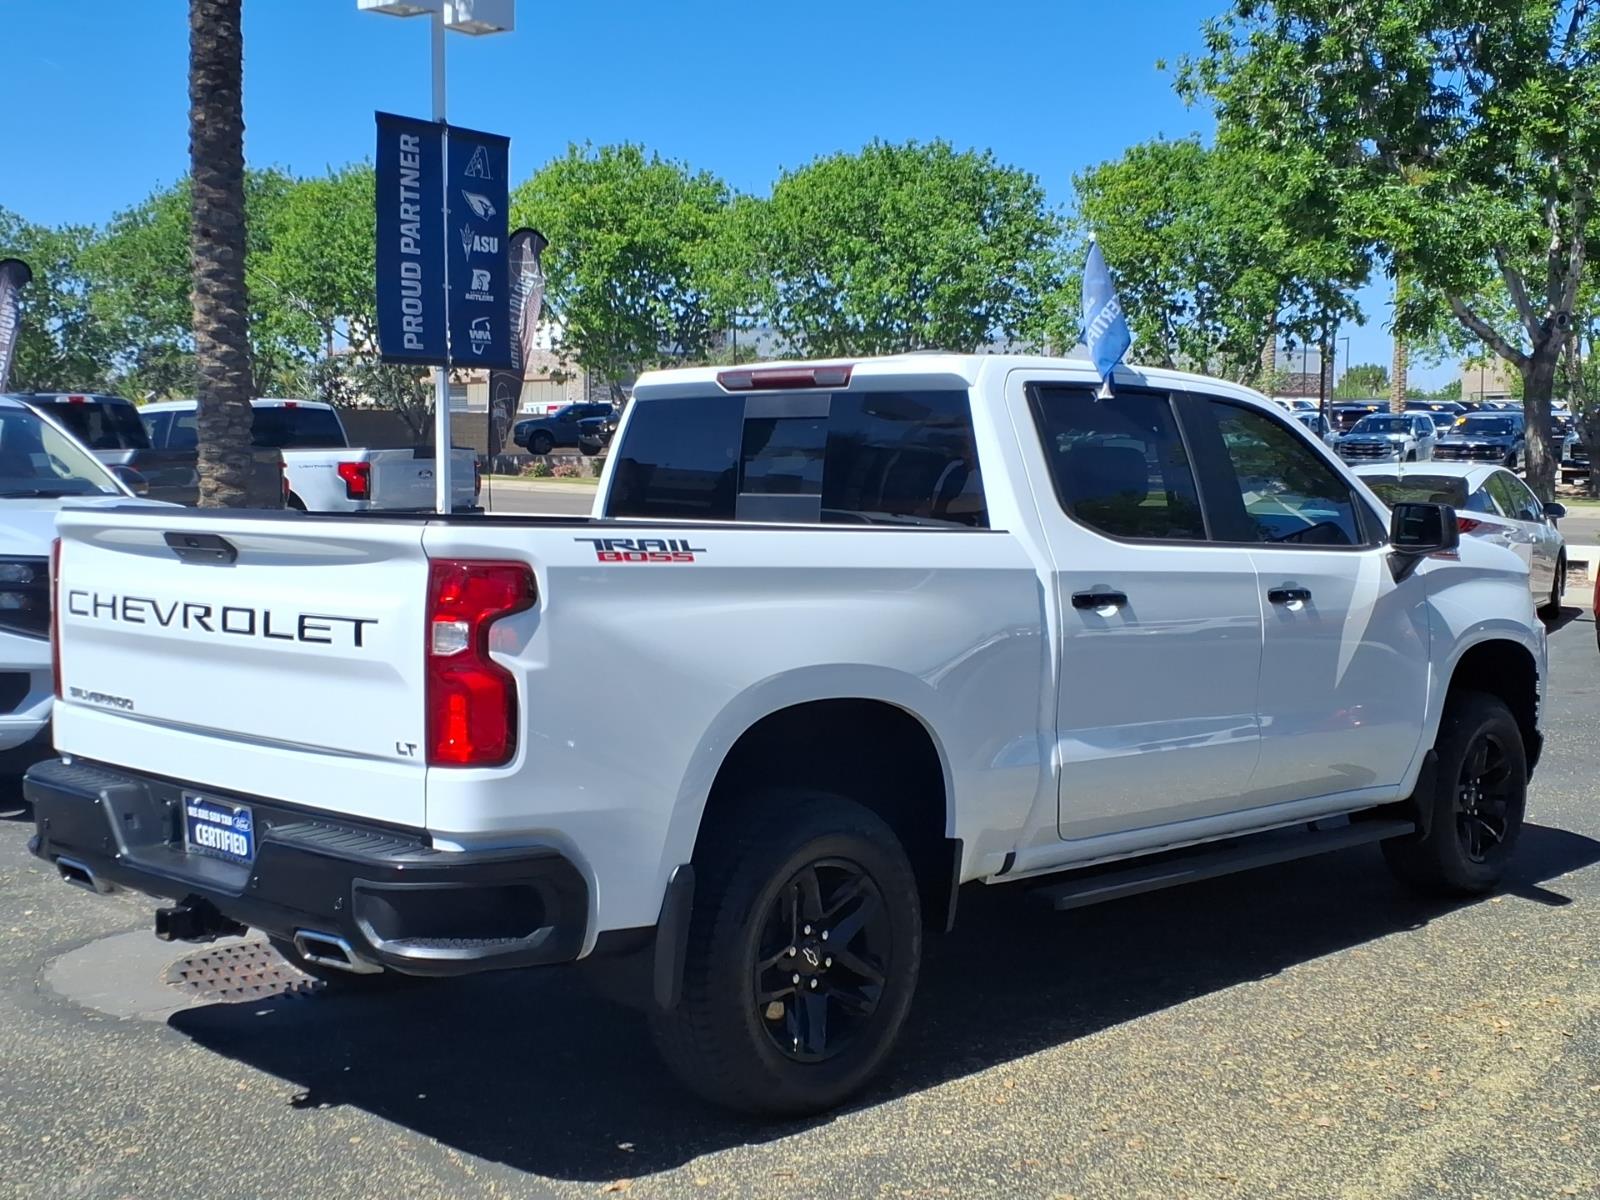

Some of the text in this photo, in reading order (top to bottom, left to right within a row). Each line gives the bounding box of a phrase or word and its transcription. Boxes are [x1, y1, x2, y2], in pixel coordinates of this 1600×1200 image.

[400, 133, 424, 349] PROUD PARTNER
[473, 233, 499, 254] ASU
[469, 329, 492, 340] WM
[574, 538, 707, 552] TRAIL
[597, 550, 695, 563] BOSS
[68, 589, 379, 649] CHEVROLET
[69, 686, 134, 711] SILVERADO
[395, 741, 417, 757] LT
[196, 825, 248, 856] CERTIFIED
